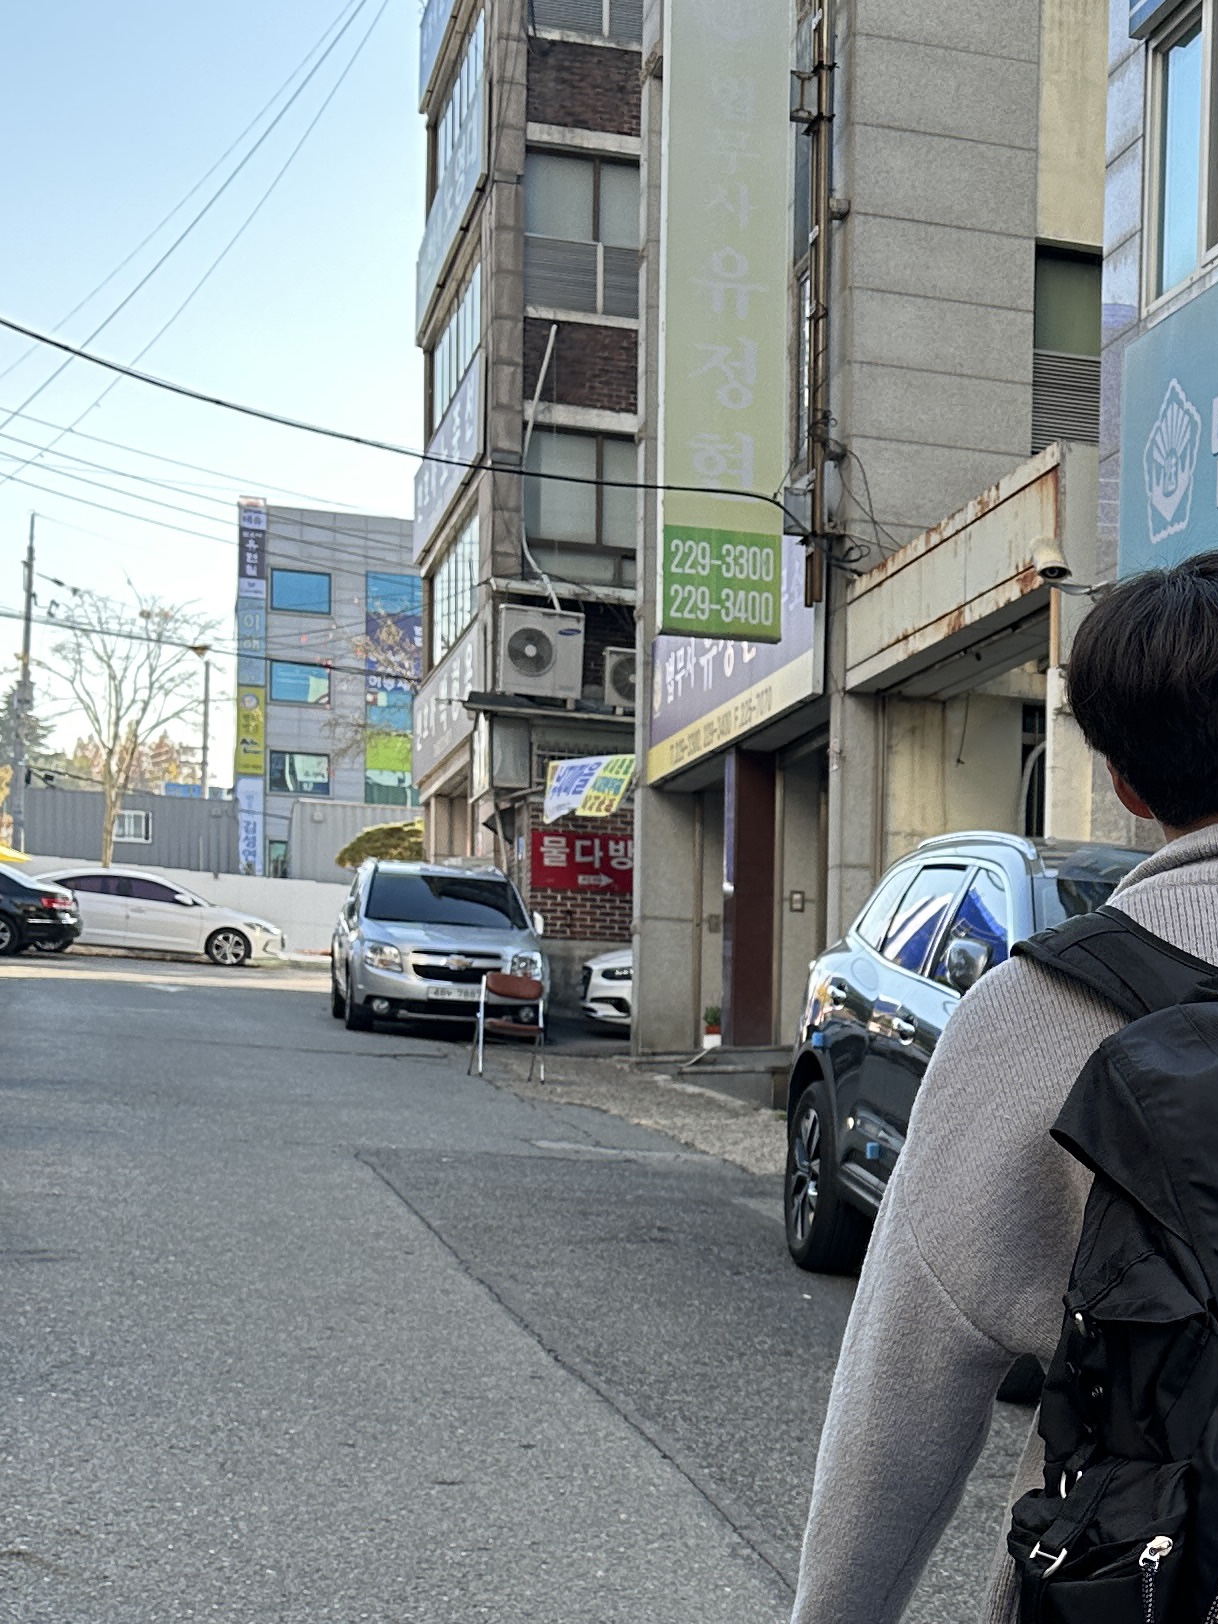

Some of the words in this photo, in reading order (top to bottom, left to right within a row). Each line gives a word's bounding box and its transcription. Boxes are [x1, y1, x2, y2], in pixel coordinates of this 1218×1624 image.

[670, 539, 774, 582] 229-3300
[670, 583, 773, 626] 229-3400
[540, 836, 633, 870] 물다방
